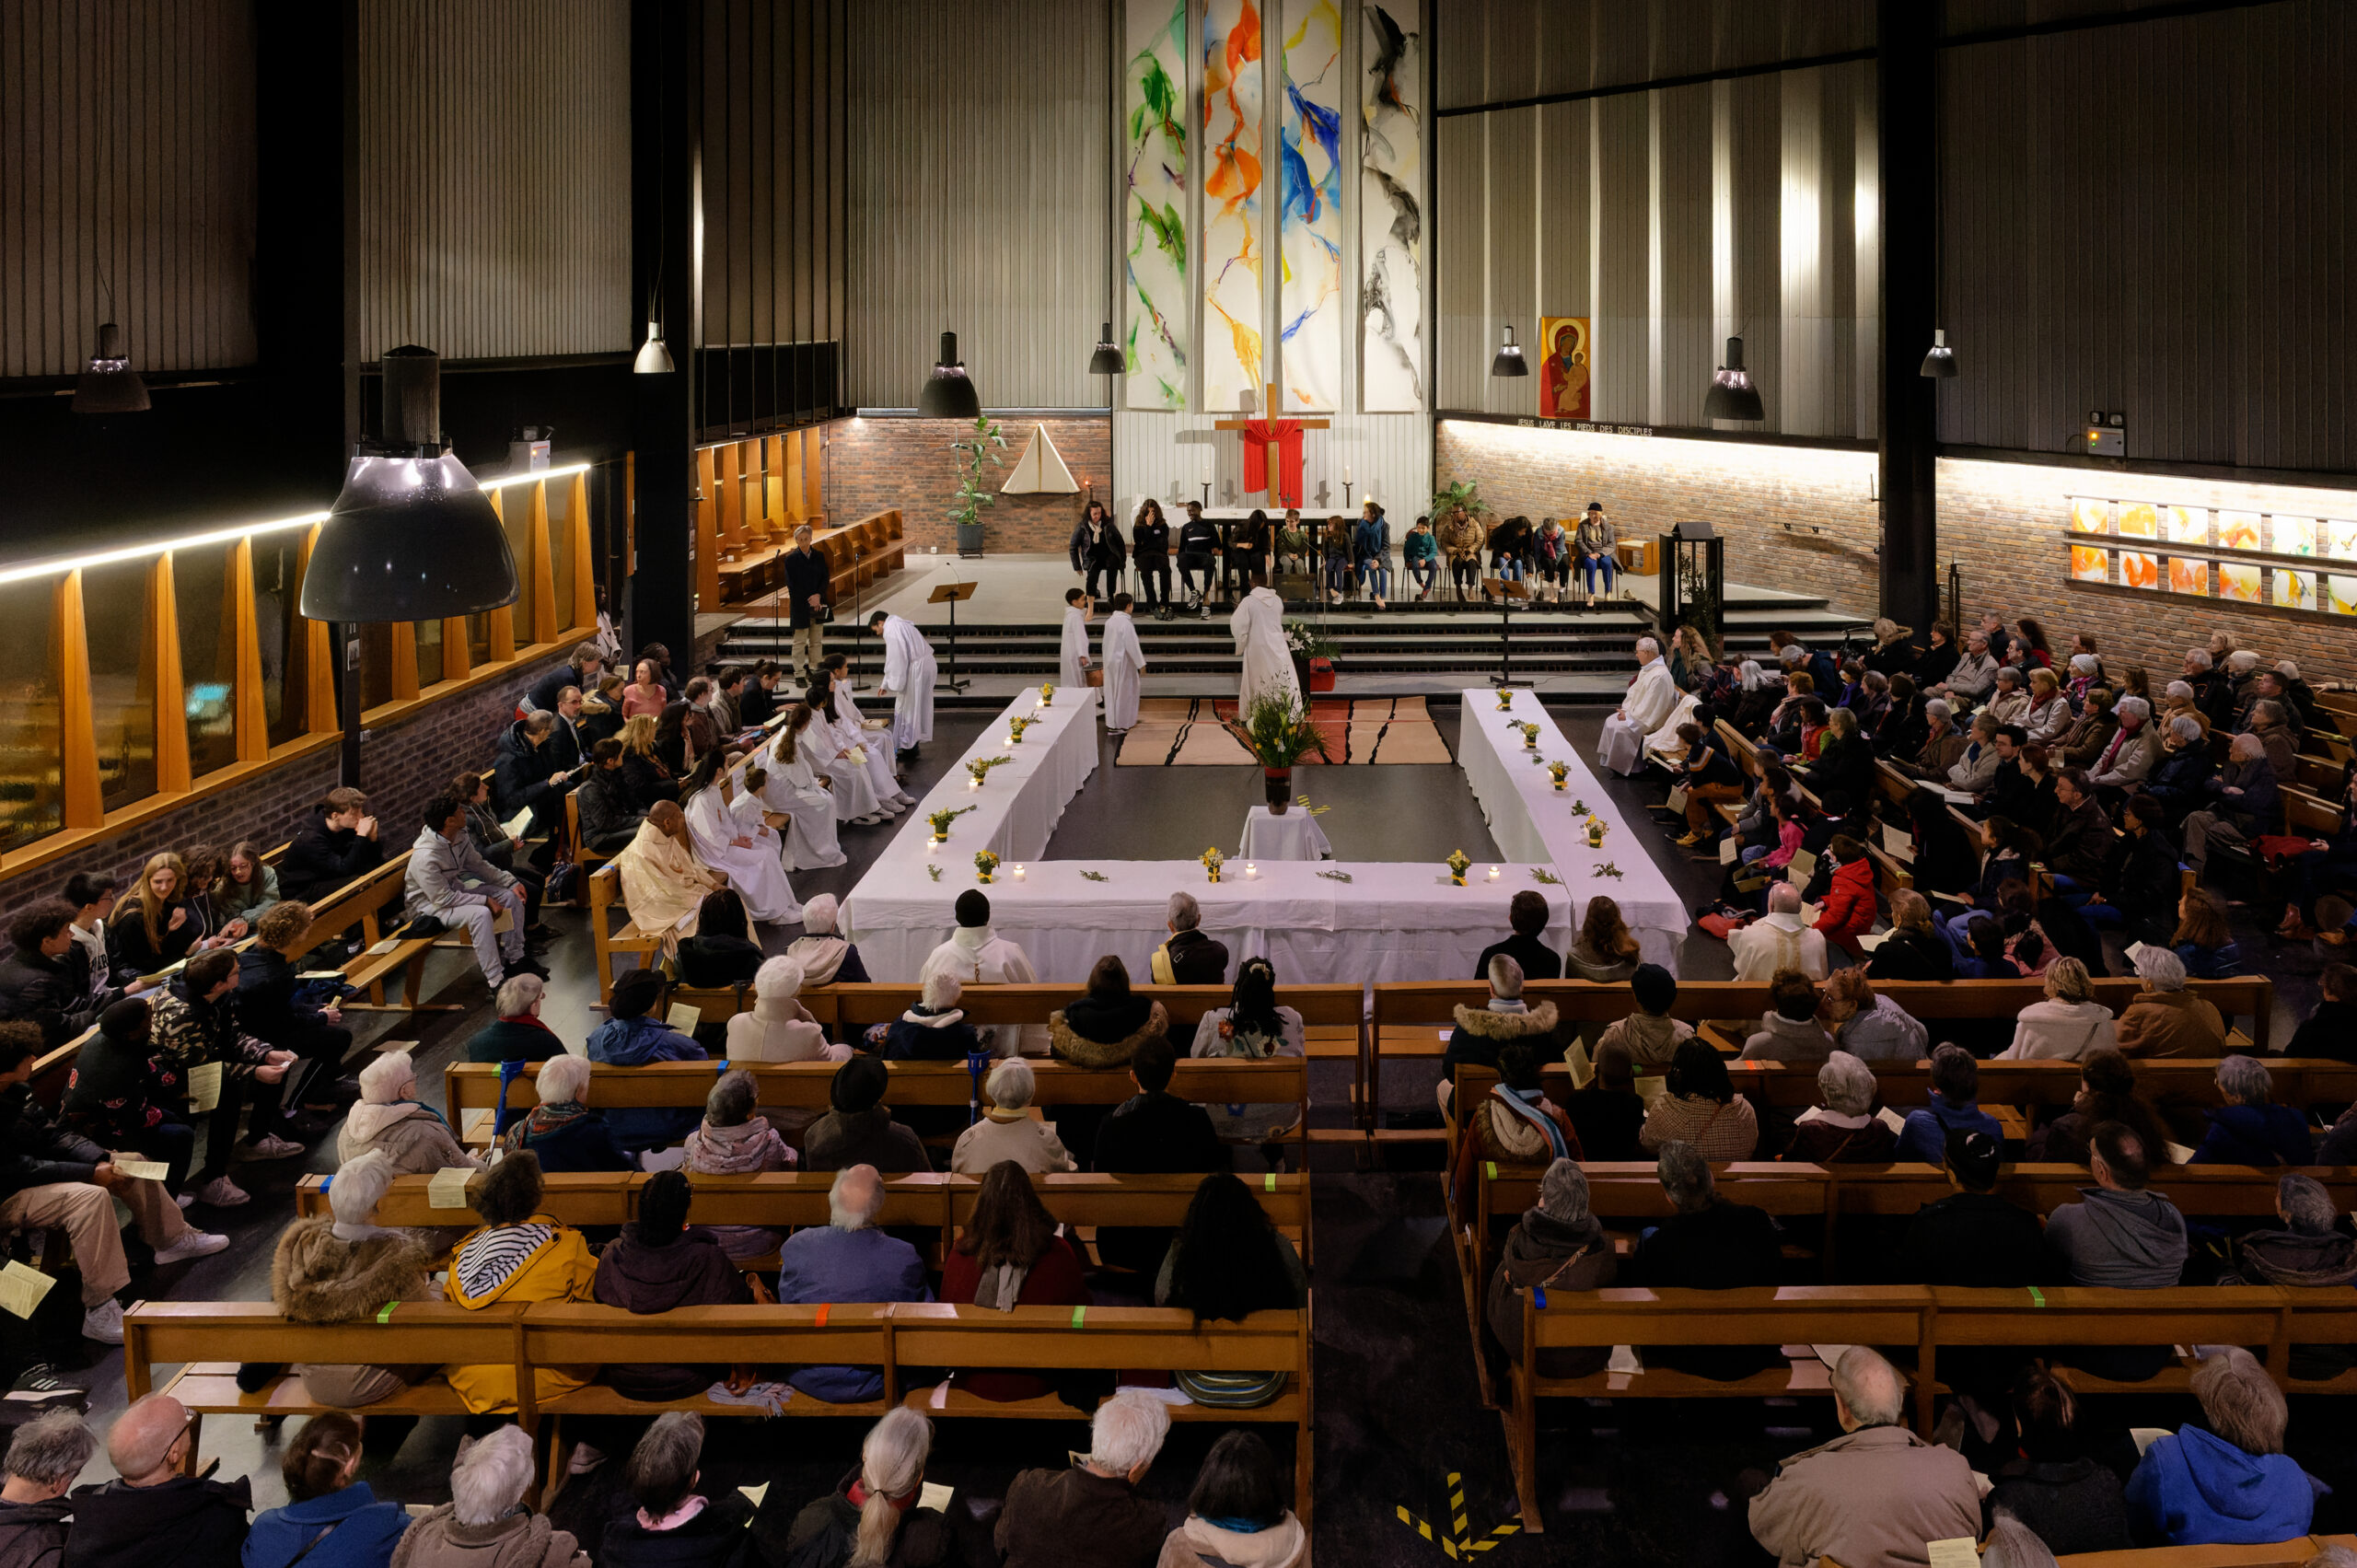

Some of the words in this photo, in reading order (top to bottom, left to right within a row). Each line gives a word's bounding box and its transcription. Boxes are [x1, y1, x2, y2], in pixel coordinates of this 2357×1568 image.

[1517, 419, 1535, 427] JESUS
[1538, 420, 1556, 429] LAVE
[1560, 422, 1572, 430] LES
[1576, 423, 1596, 433] PIEDS
[1600, 424, 1613, 434] DES
[1618, 425, 1653, 436] DISCIPLES
